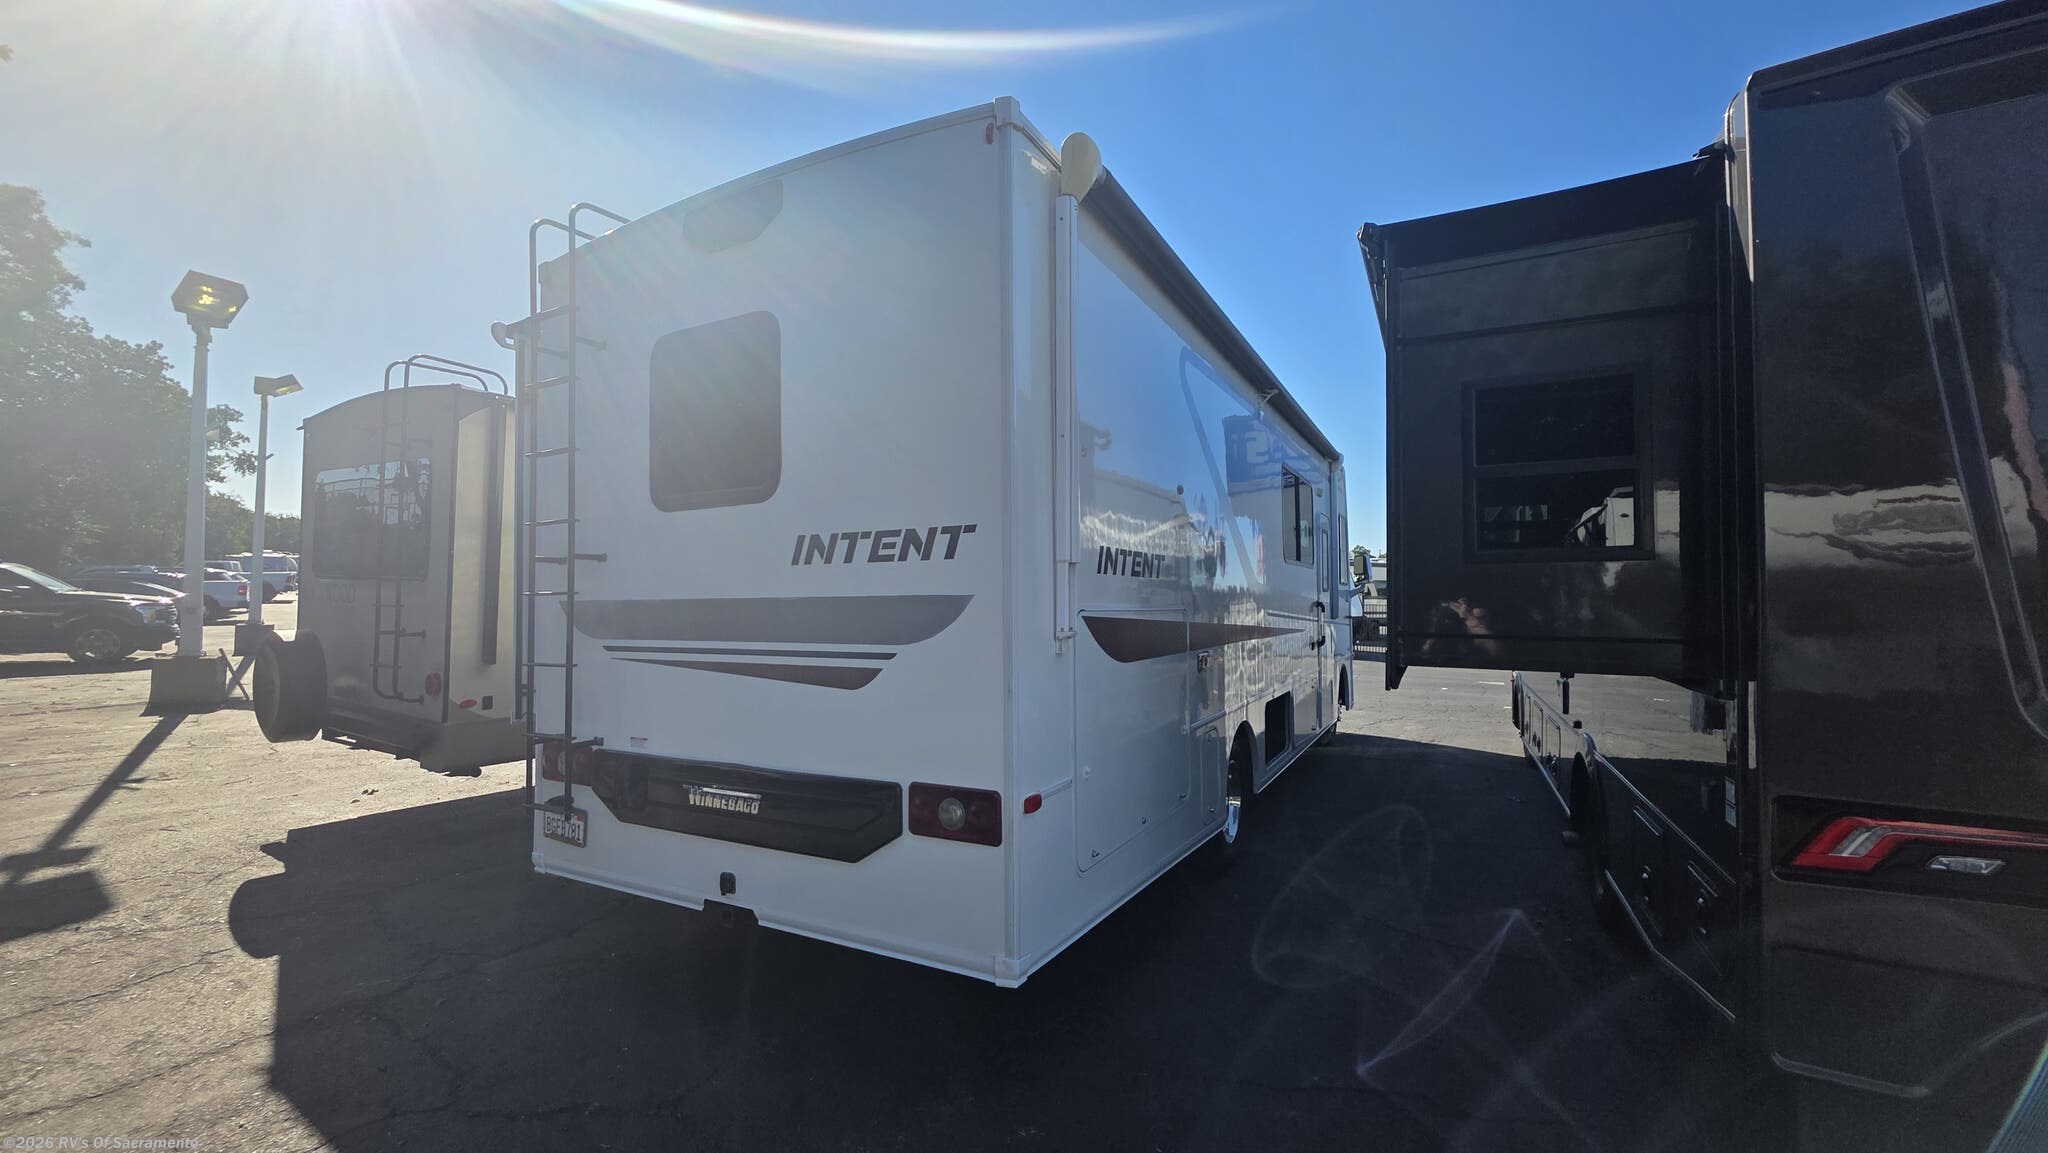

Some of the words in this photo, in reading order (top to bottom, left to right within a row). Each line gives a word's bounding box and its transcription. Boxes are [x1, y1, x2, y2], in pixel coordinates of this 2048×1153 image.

[791, 524, 977, 566] INTENT
[1096, 545, 1166, 579] INTENT
[688, 793, 761, 815] WINNEBAGO
